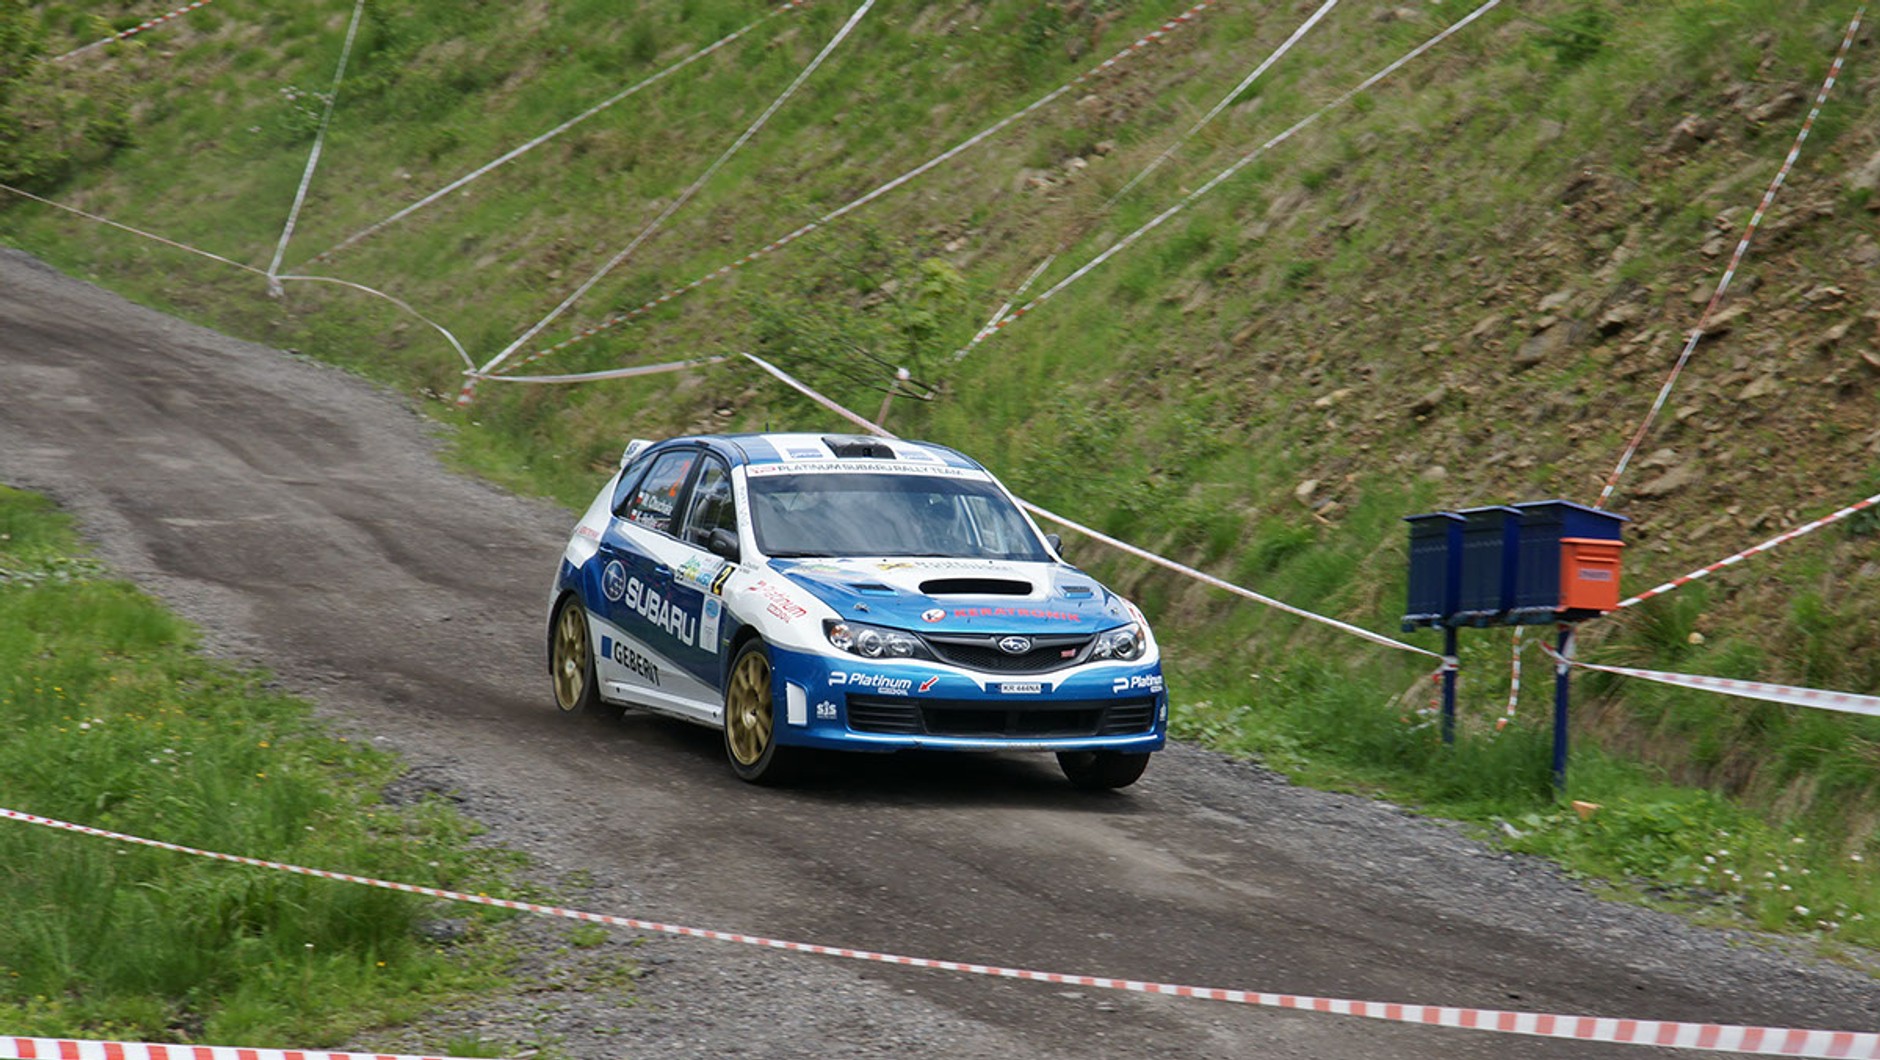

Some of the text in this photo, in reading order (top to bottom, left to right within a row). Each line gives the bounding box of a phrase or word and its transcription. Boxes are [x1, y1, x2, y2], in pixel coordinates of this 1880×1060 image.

[777, 463, 841, 472] PLATINUM
[842, 463, 893, 472] SUBARU
[893, 465, 928, 473] RALLY
[930, 466, 964, 475] TEAM
[713, 565, 733, 596] 2
[625, 576, 696, 647] SUBARU
[953, 607, 1082, 623] KERATRONIK
[613, 641, 661, 687] GEBERIT
[848, 672, 912, 689] Platinum
